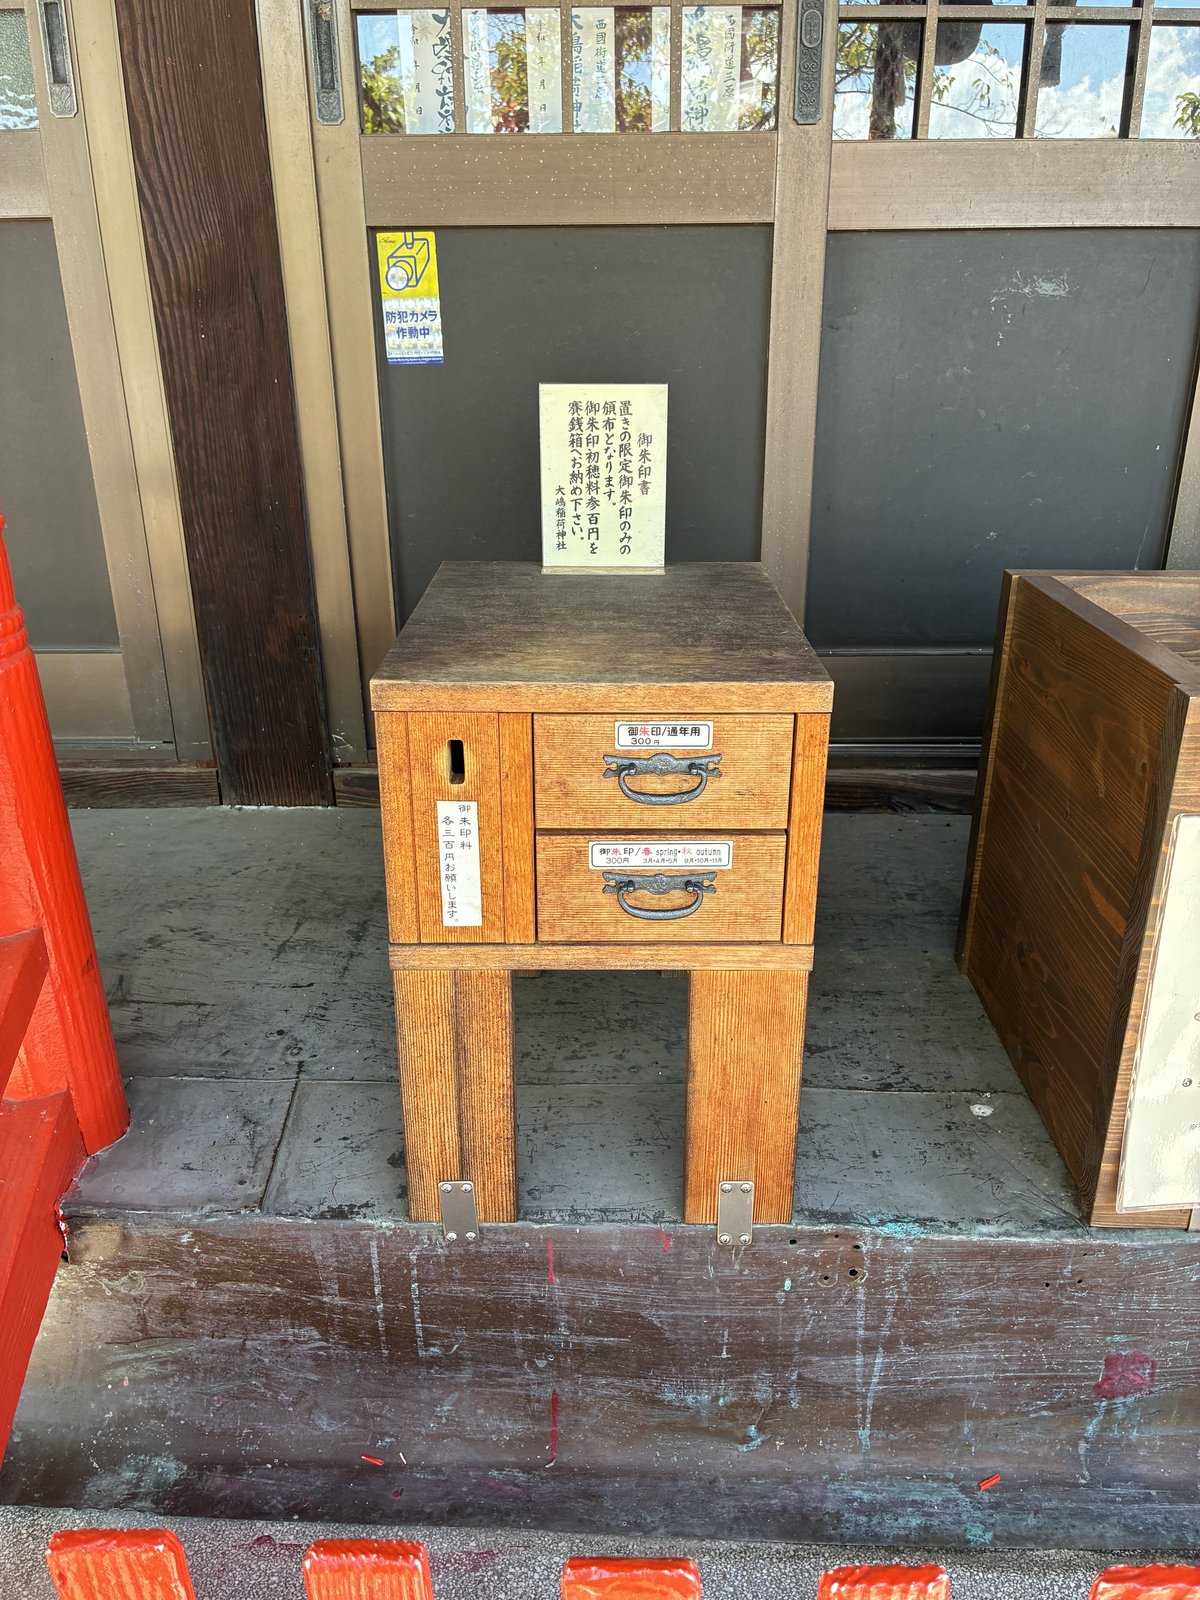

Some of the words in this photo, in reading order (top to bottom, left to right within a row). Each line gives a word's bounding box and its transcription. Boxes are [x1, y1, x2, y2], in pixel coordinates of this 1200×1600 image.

[386, 311, 438, 324] 防犯カメラ
[396, 326, 430, 339] 作動中
[568, 400, 584, 541] 賽銭箱へお納め下さい。
[585, 400, 600, 555] 御朱印初穂料参百円を
[602, 400, 617, 506] 頒布となります。
[618, 400, 633, 555] 置きの限定御朱印のみの
[637, 432, 652, 496] 御朱印書
[555, 485, 567, 550] 大嶋稲荷神社
[628, 726, 700, 737] 御朱印/通年用
[458, 804, 472, 850] 御朱印料
[441, 815, 459, 923] 各三百円お願いします。
